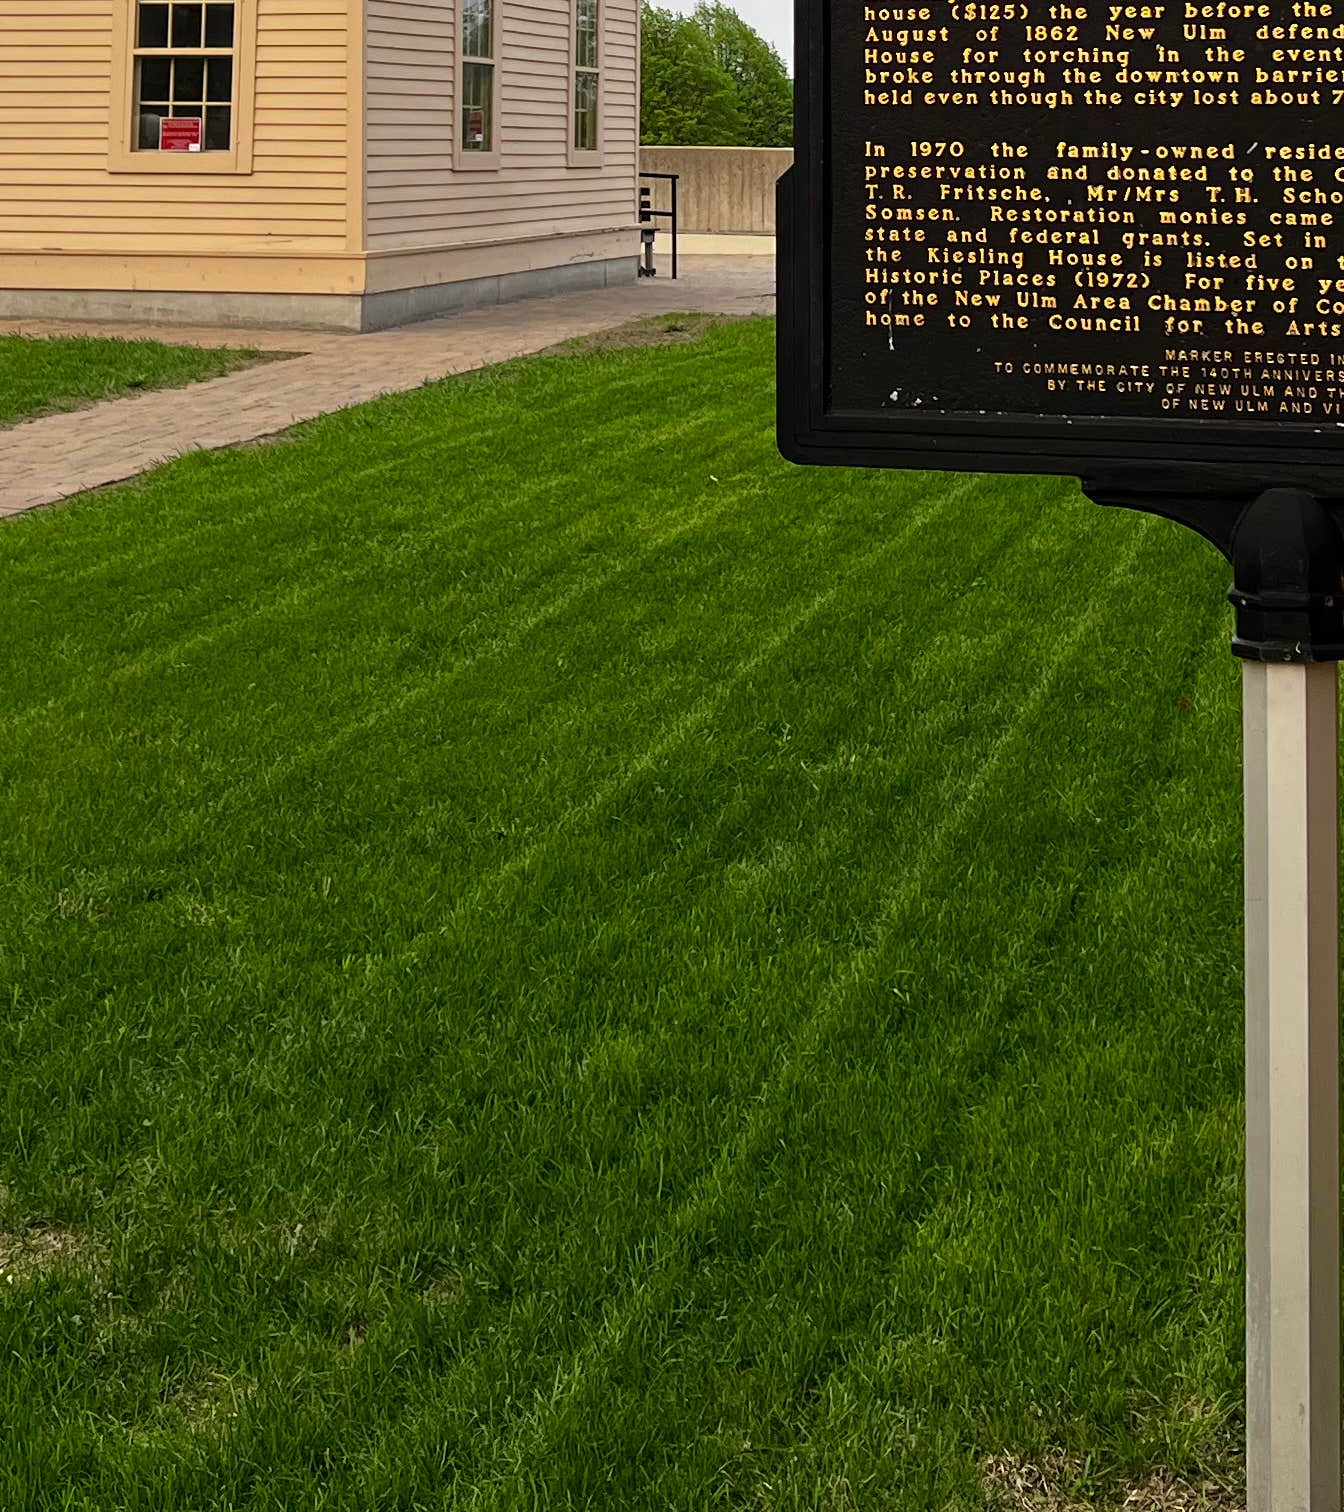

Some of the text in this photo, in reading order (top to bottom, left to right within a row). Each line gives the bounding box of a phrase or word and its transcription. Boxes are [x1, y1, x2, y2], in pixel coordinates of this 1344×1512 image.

[864, 6, 931, 21] house
[951, 2, 1029, 22] ($125)
[1049, 3, 1088, 20] the
[1108, 5, 1165, 22] year
[1184, 1, 1271, 19] before
[1291, 1, 1333, 18] the
[865, 26, 949, 47] August
[975, 25, 999, 42] of
[1025, 25, 1079, 42] 1862
[1105, 23, 1156, 41] New
[1182, 23, 1227, 41] Ulm
[864, 48, 935, 64] House
[962, 47, 999, 64] for
[1022, 47, 1130, 68] torching
[1155, 44, 1180, 63] in
[1204, 46, 1246, 62] the
[1272, 46, 1343, 62] event
[865, 67, 934, 84] broke
[950, 68, 1046, 89] through
[1062, 67, 1103, 84] the
[1115, 67, 1240, 84] downtown
[863, 89, 913, 106] held
[923, 92, 979, 105] even
[990, 89, 1074, 109] though
[1083, 89, 1123, 105] the
[1134, 89, 1184, 108] city
[1193, 89, 1240, 105] lost
[1250, 88, 1321, 105] about
[864, 141, 886, 157] In
[911, 141, 965, 158] 1970
[991, 141, 1029, 158] the
[1056, 141, 1235, 162] family-owned
[865, 203, 961, 221] Somsen.
[990, 205, 1135, 224] Restoration
[1158, 207, 1247, 225] monies
[1269, 212, 1334, 226] came
[865, 246, 902, 263] the
[927, 247, 1024, 270] Kiesling
[1048, 249, 1123, 267] House
[1143, 250, 1163, 267] is
[1186, 251, 1258, 269] listed
[1285, 256, 1313, 270] on
[865, 267, 963, 285] Historic
[979, 269, 1057, 287] Places
[1184, 272, 1225, 290] For
[1245, 274, 1296, 292] five
[1165, 349, 1233, 363] MARKER
[1243, 351, 1320, 365] ERECTED
[993, 361, 1013, 374] TO
[1022, 362, 1150, 377] COMMEMORATE
[1158, 365, 1190, 378] THE
[1200, 367, 1252, 379] 140TH
[1047, 379, 1066, 391] BY
[1075, 379, 1107, 392] THE
[1116, 381, 1155, 393] CITY
[1165, 382, 1186, 395] OF
[1194, 383, 1232, 396] NEW
[1240, 384, 1275, 397] ULM
[1284, 385, 1318, 399] AND
[1161, 397, 1181, 410] OF
[1188, 398, 1226, 411] NEW
[1235, 399, 1269, 412] ULM
[1279, 401, 1313, 414] AND
